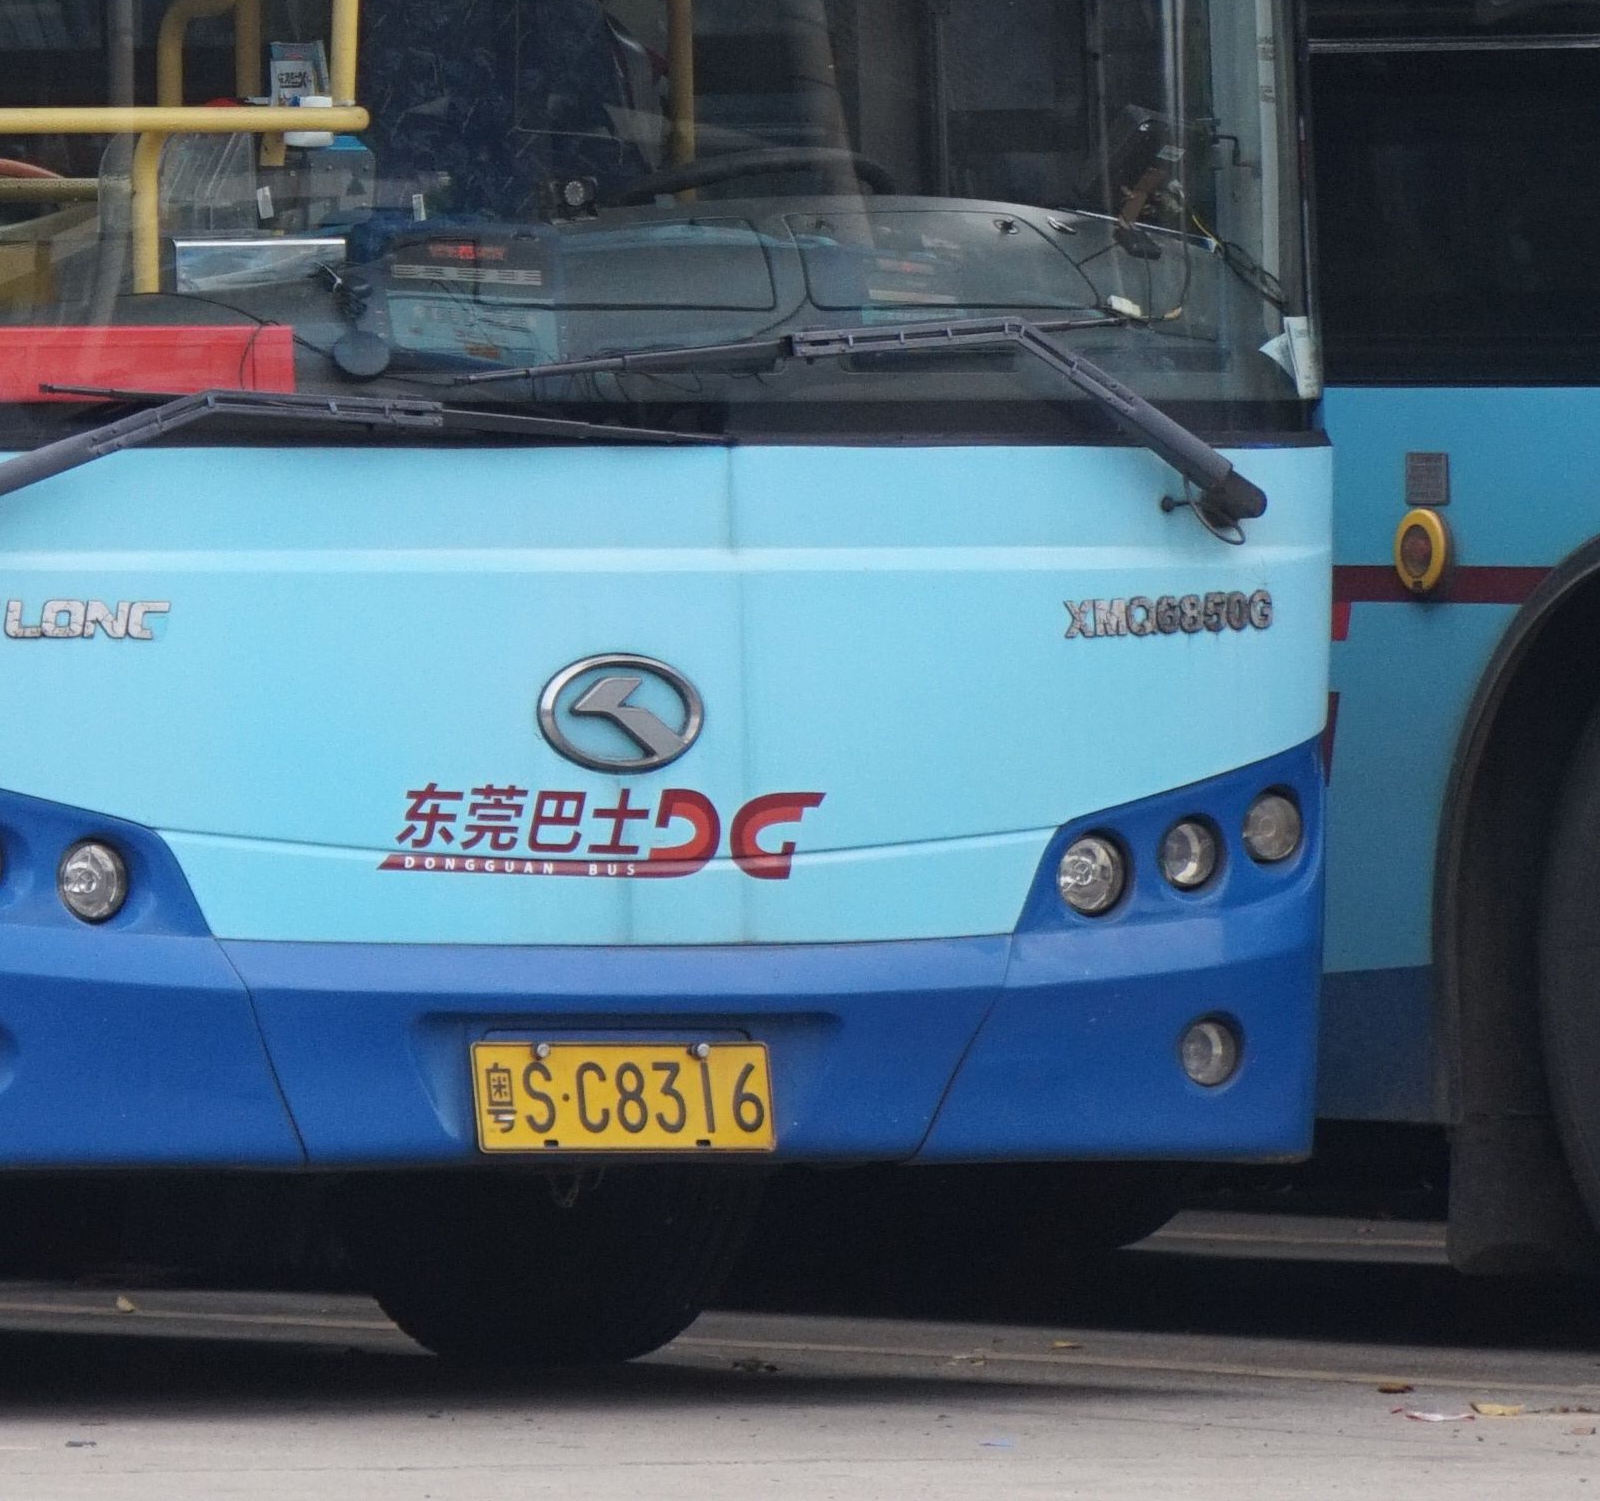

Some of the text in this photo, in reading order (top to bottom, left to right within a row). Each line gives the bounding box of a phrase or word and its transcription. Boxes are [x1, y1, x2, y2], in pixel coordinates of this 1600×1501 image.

[1063, 588, 1274, 639] XMQ6850G
[394, 781, 651, 856] 东莞巴士
[404, 855, 636, 877] DONGGUAN BUS
